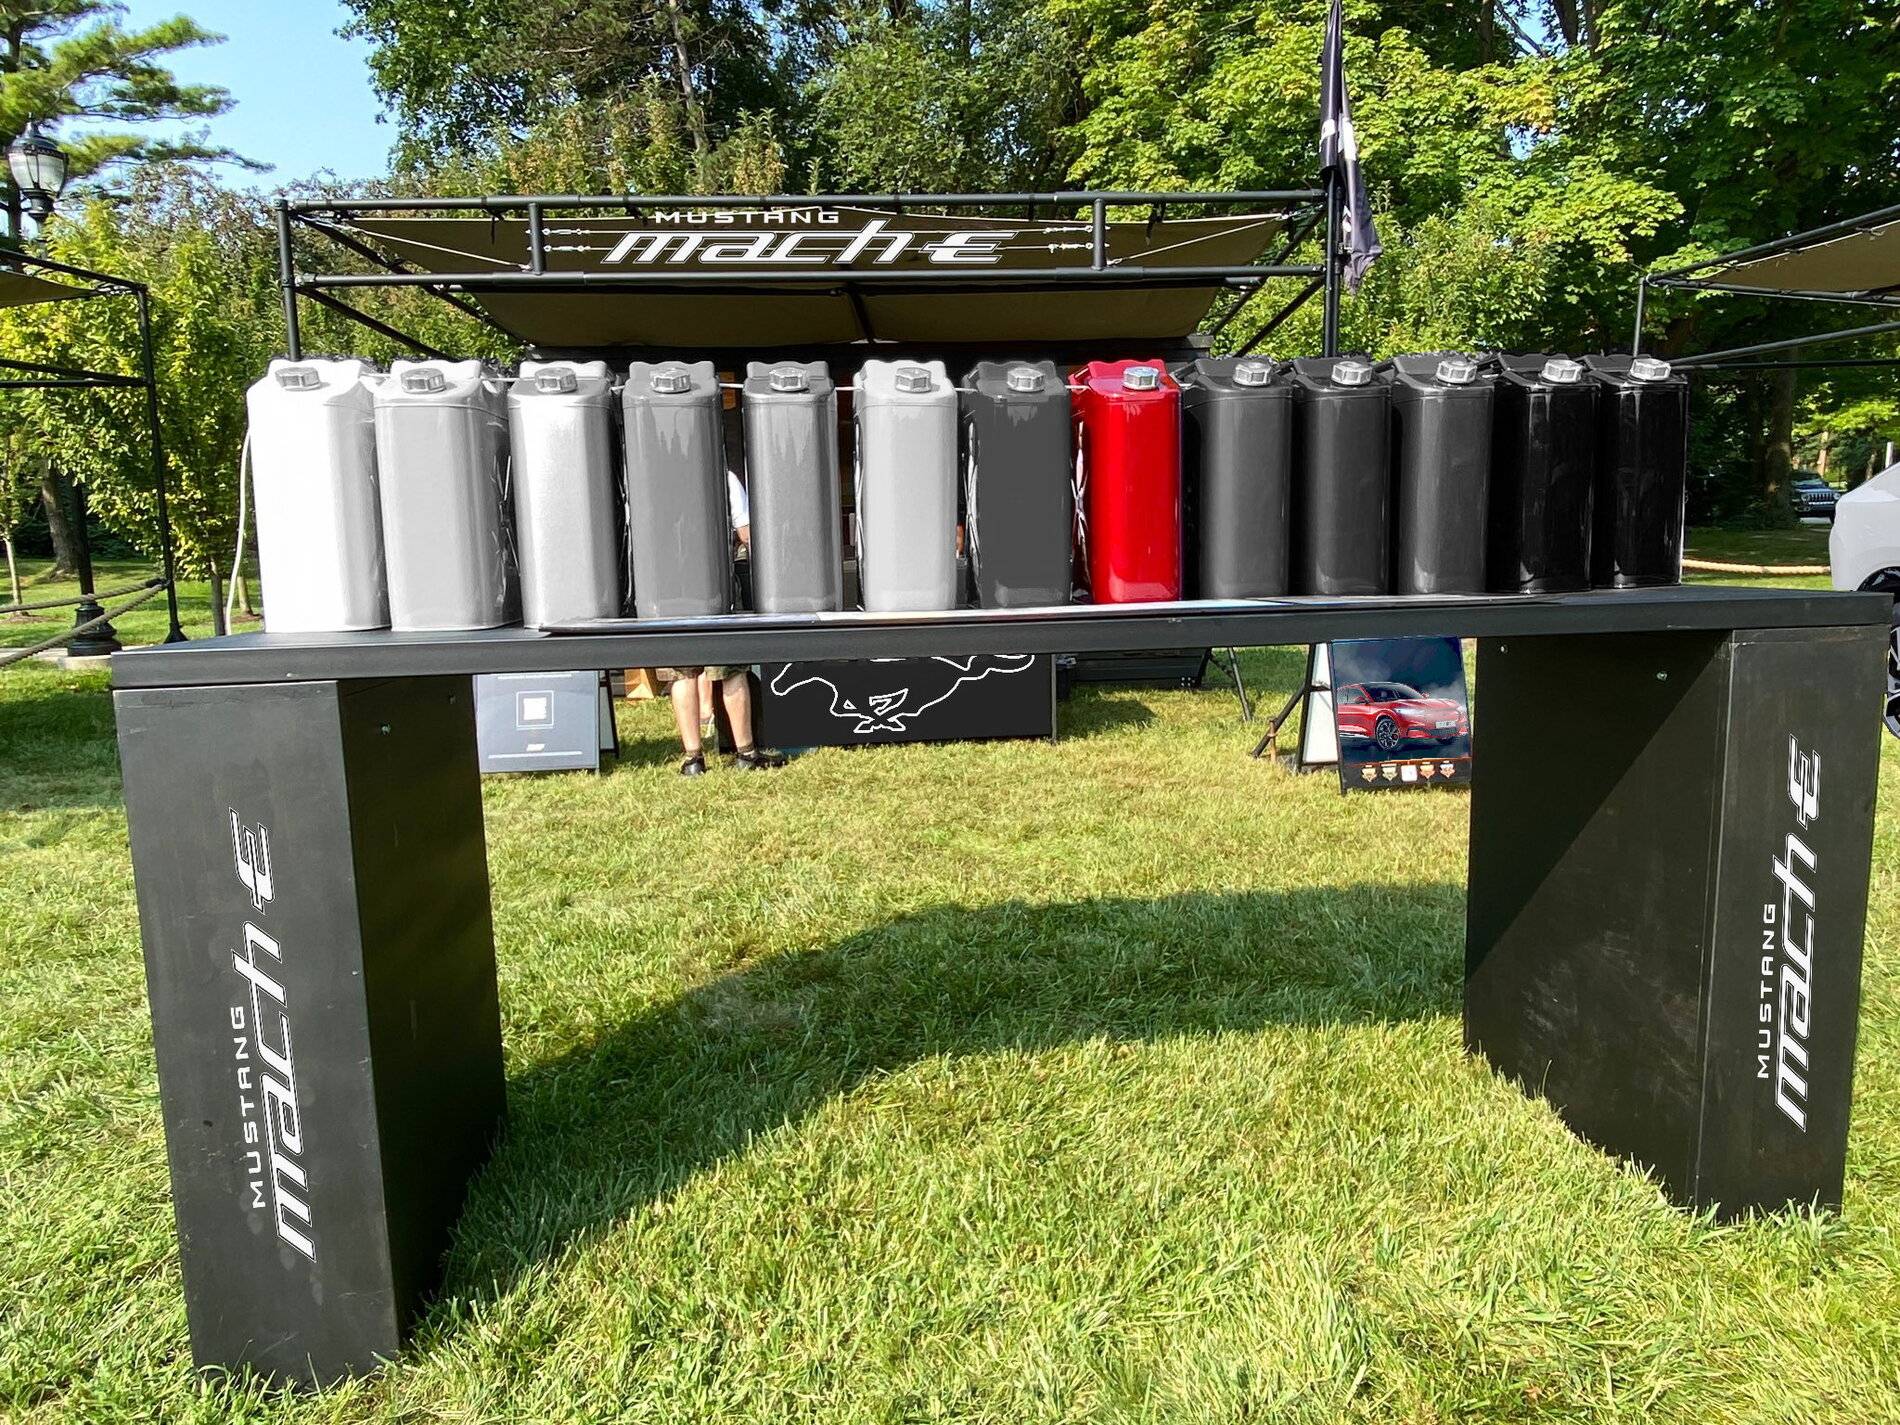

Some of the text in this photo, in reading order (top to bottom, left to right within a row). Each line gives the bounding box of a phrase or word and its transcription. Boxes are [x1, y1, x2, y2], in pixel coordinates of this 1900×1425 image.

[655, 210, 839, 224] MUSTANG
[1757, 903, 1776, 1079] MUSTANG
[230, 1005, 266, 1209] MUSTANG
